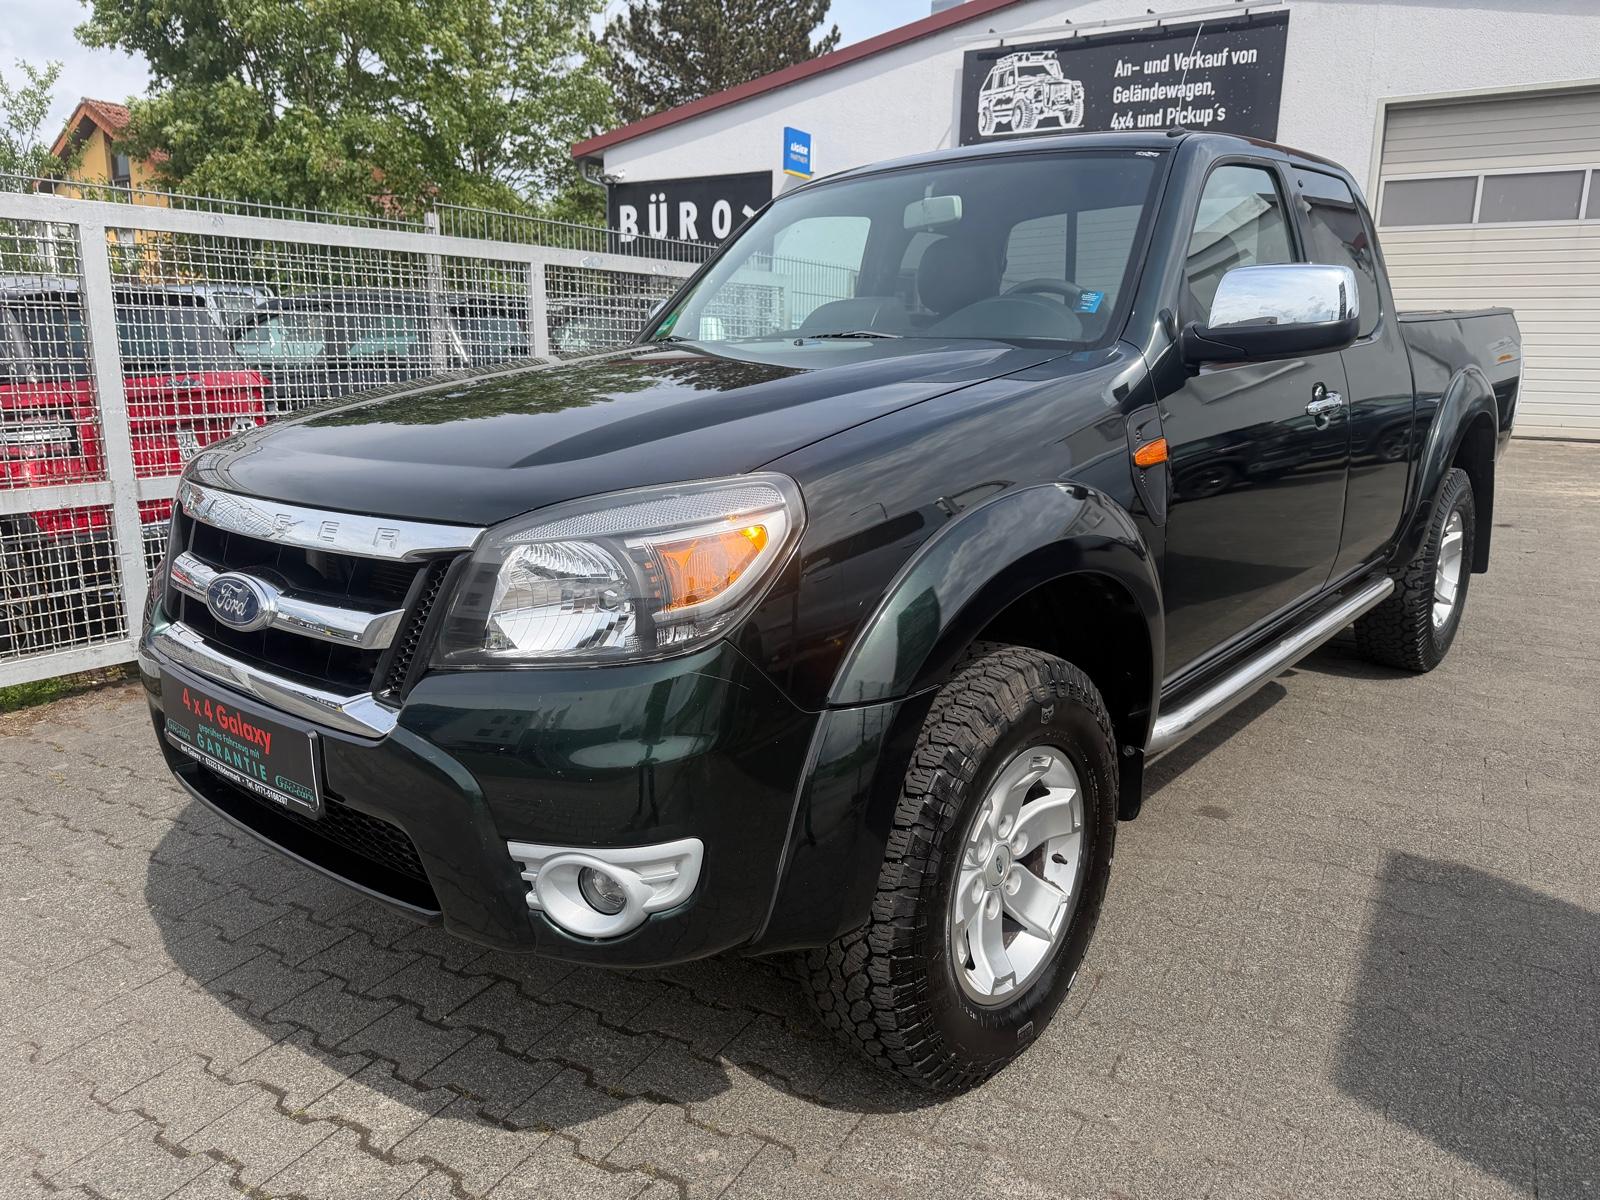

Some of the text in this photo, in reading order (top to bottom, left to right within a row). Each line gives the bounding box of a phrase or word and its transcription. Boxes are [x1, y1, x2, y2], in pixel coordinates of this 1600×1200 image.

[1114, 47, 1258, 78] An- und Verkauf von
[1113, 80, 1216, 104] Geländewagen,
[1110, 111, 1135, 130] 4x4
[1137, 108, 1162, 128] und
[619, 192, 732, 243] BÜRO
[217, 582, 247, 615] Ford
[216, 705, 272, 754] Galaxy
[197, 734, 267, 781] GARANTIE
